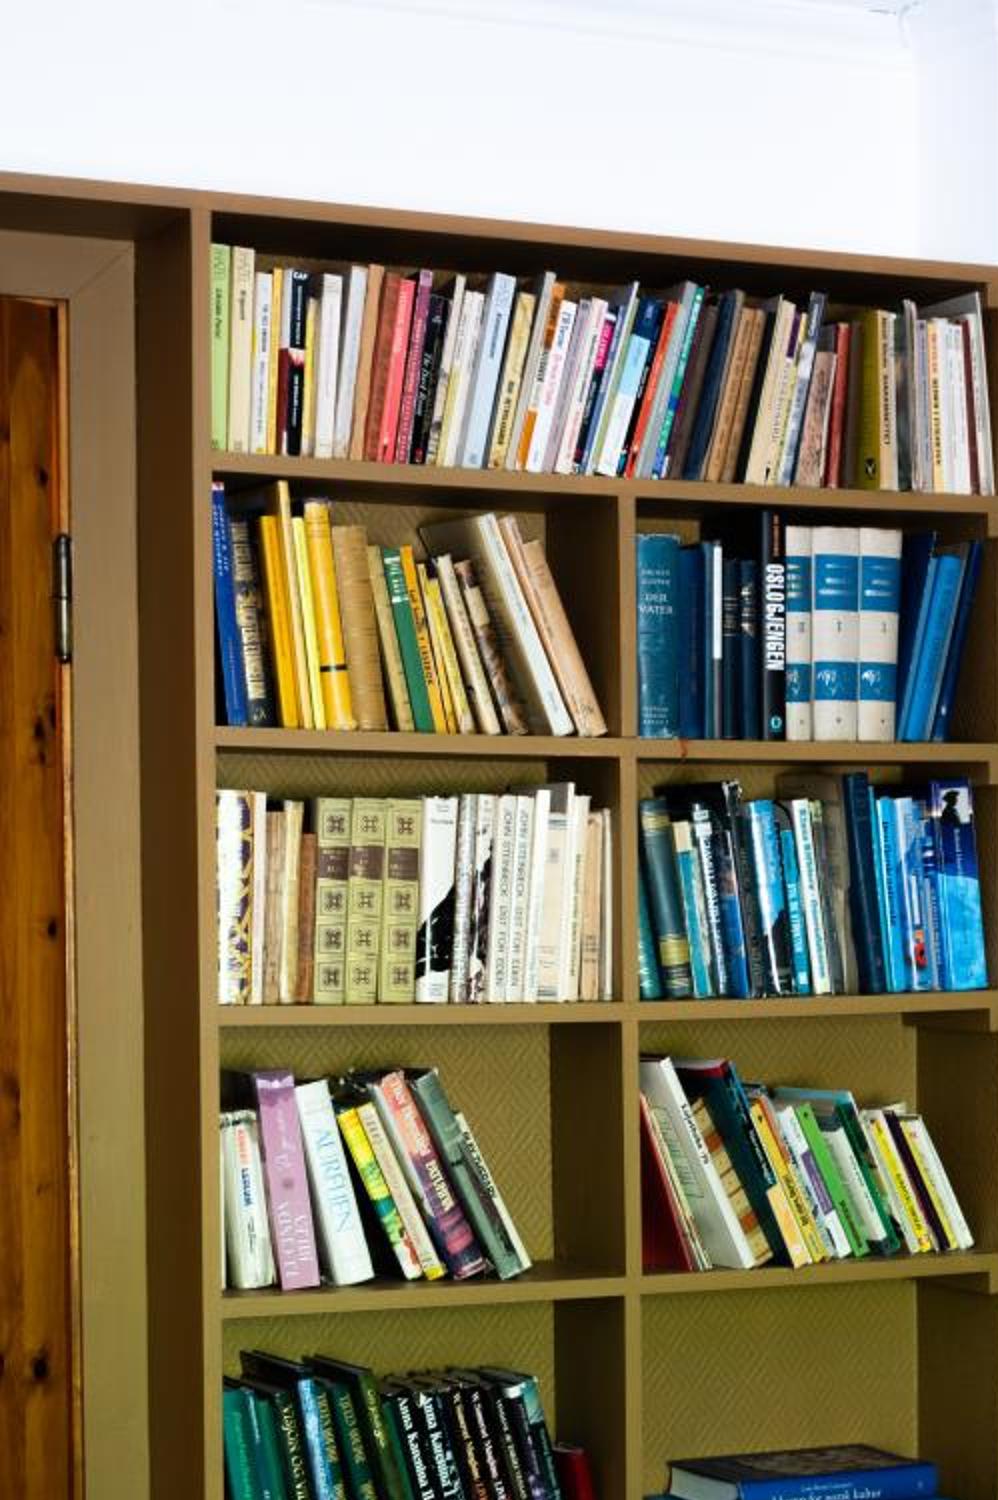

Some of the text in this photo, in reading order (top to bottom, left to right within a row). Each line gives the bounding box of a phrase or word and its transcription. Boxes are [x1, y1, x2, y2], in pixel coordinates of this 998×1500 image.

[764, 563, 786, 671] OSLOGJENGEN
[421, 1396, 439, 1429] Anna
[397, 1395, 415, 1430] Anna
[406, 1431, 430, 1488] Karenina
[429, 1431, 453, 1487] Karenina
[853, 1488, 882, 1500] kultur
